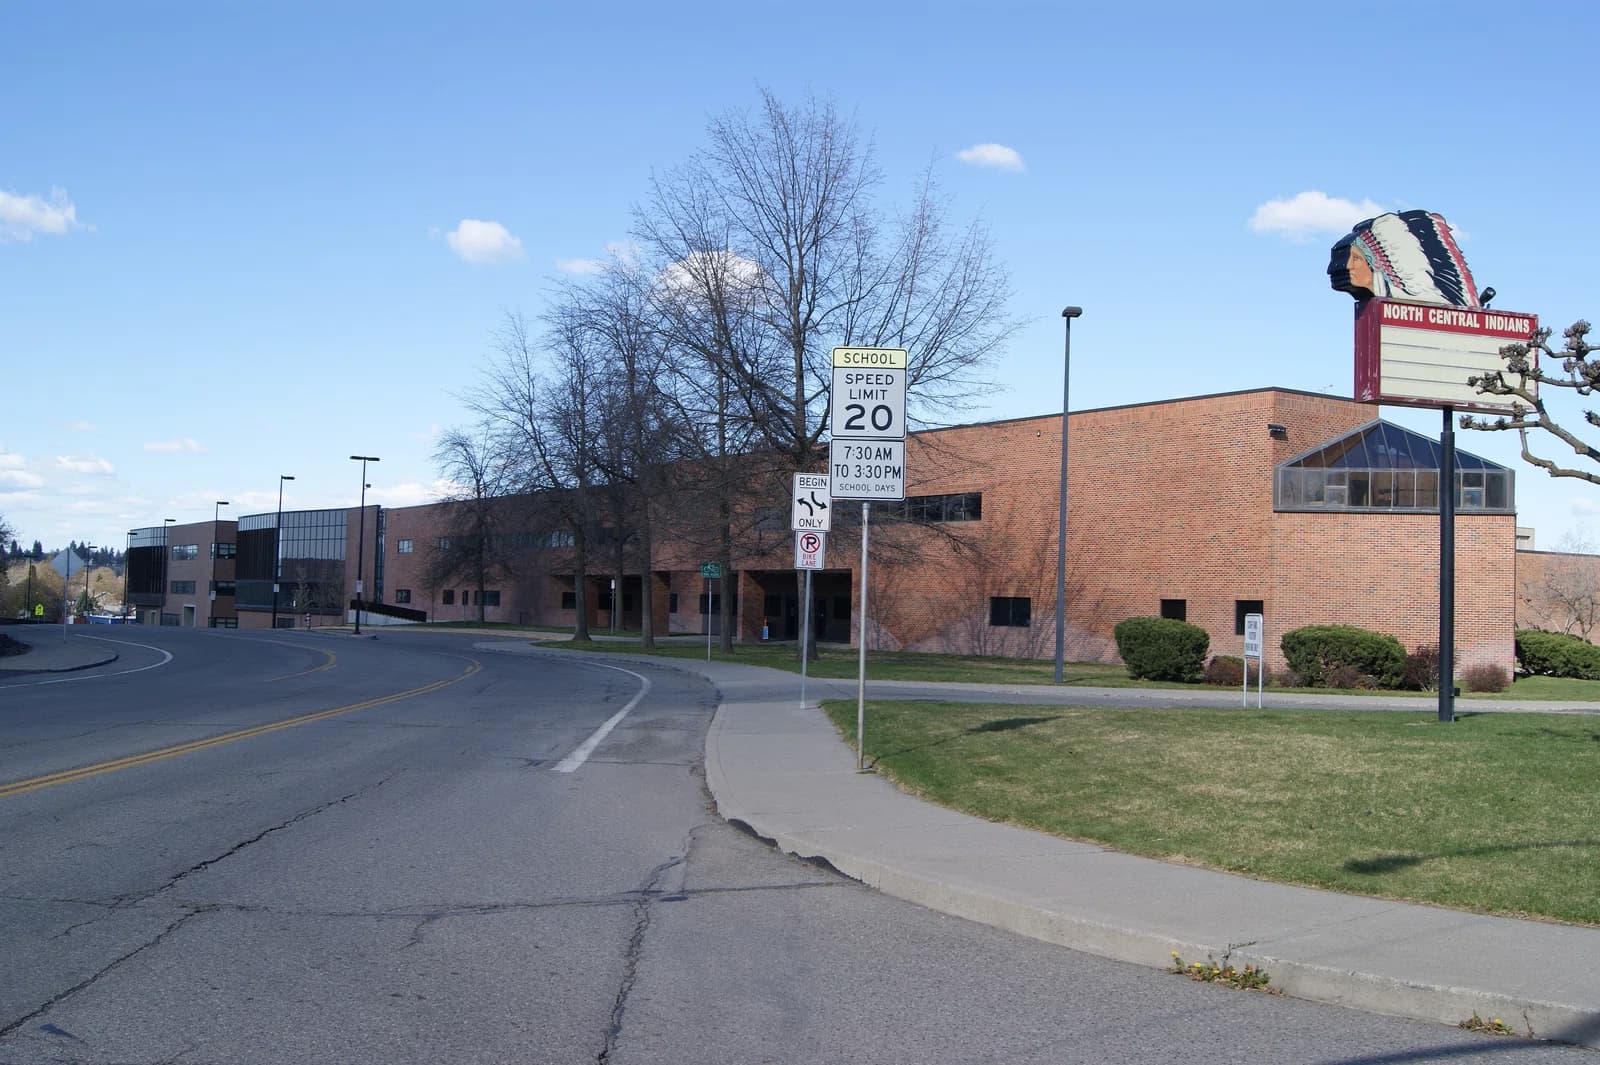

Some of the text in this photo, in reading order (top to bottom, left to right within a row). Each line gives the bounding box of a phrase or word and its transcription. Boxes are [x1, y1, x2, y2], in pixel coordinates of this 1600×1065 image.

[1383, 304, 1530, 334] NORTH CENTRAL INDIANS
[844, 353, 896, 365] SCHOOL
[845, 374, 894, 385] SPEED
[849, 389, 888, 400] LIMIT
[844, 404, 893, 431] 20
[844, 446, 892, 461] 7:30 AM
[834, 464, 901, 480] TO 3:30 PM
[799, 477, 827, 487] BEGIN
[839, 483, 896, 492] SCHOOL DAYS
[799, 518, 823, 528] ONLY
